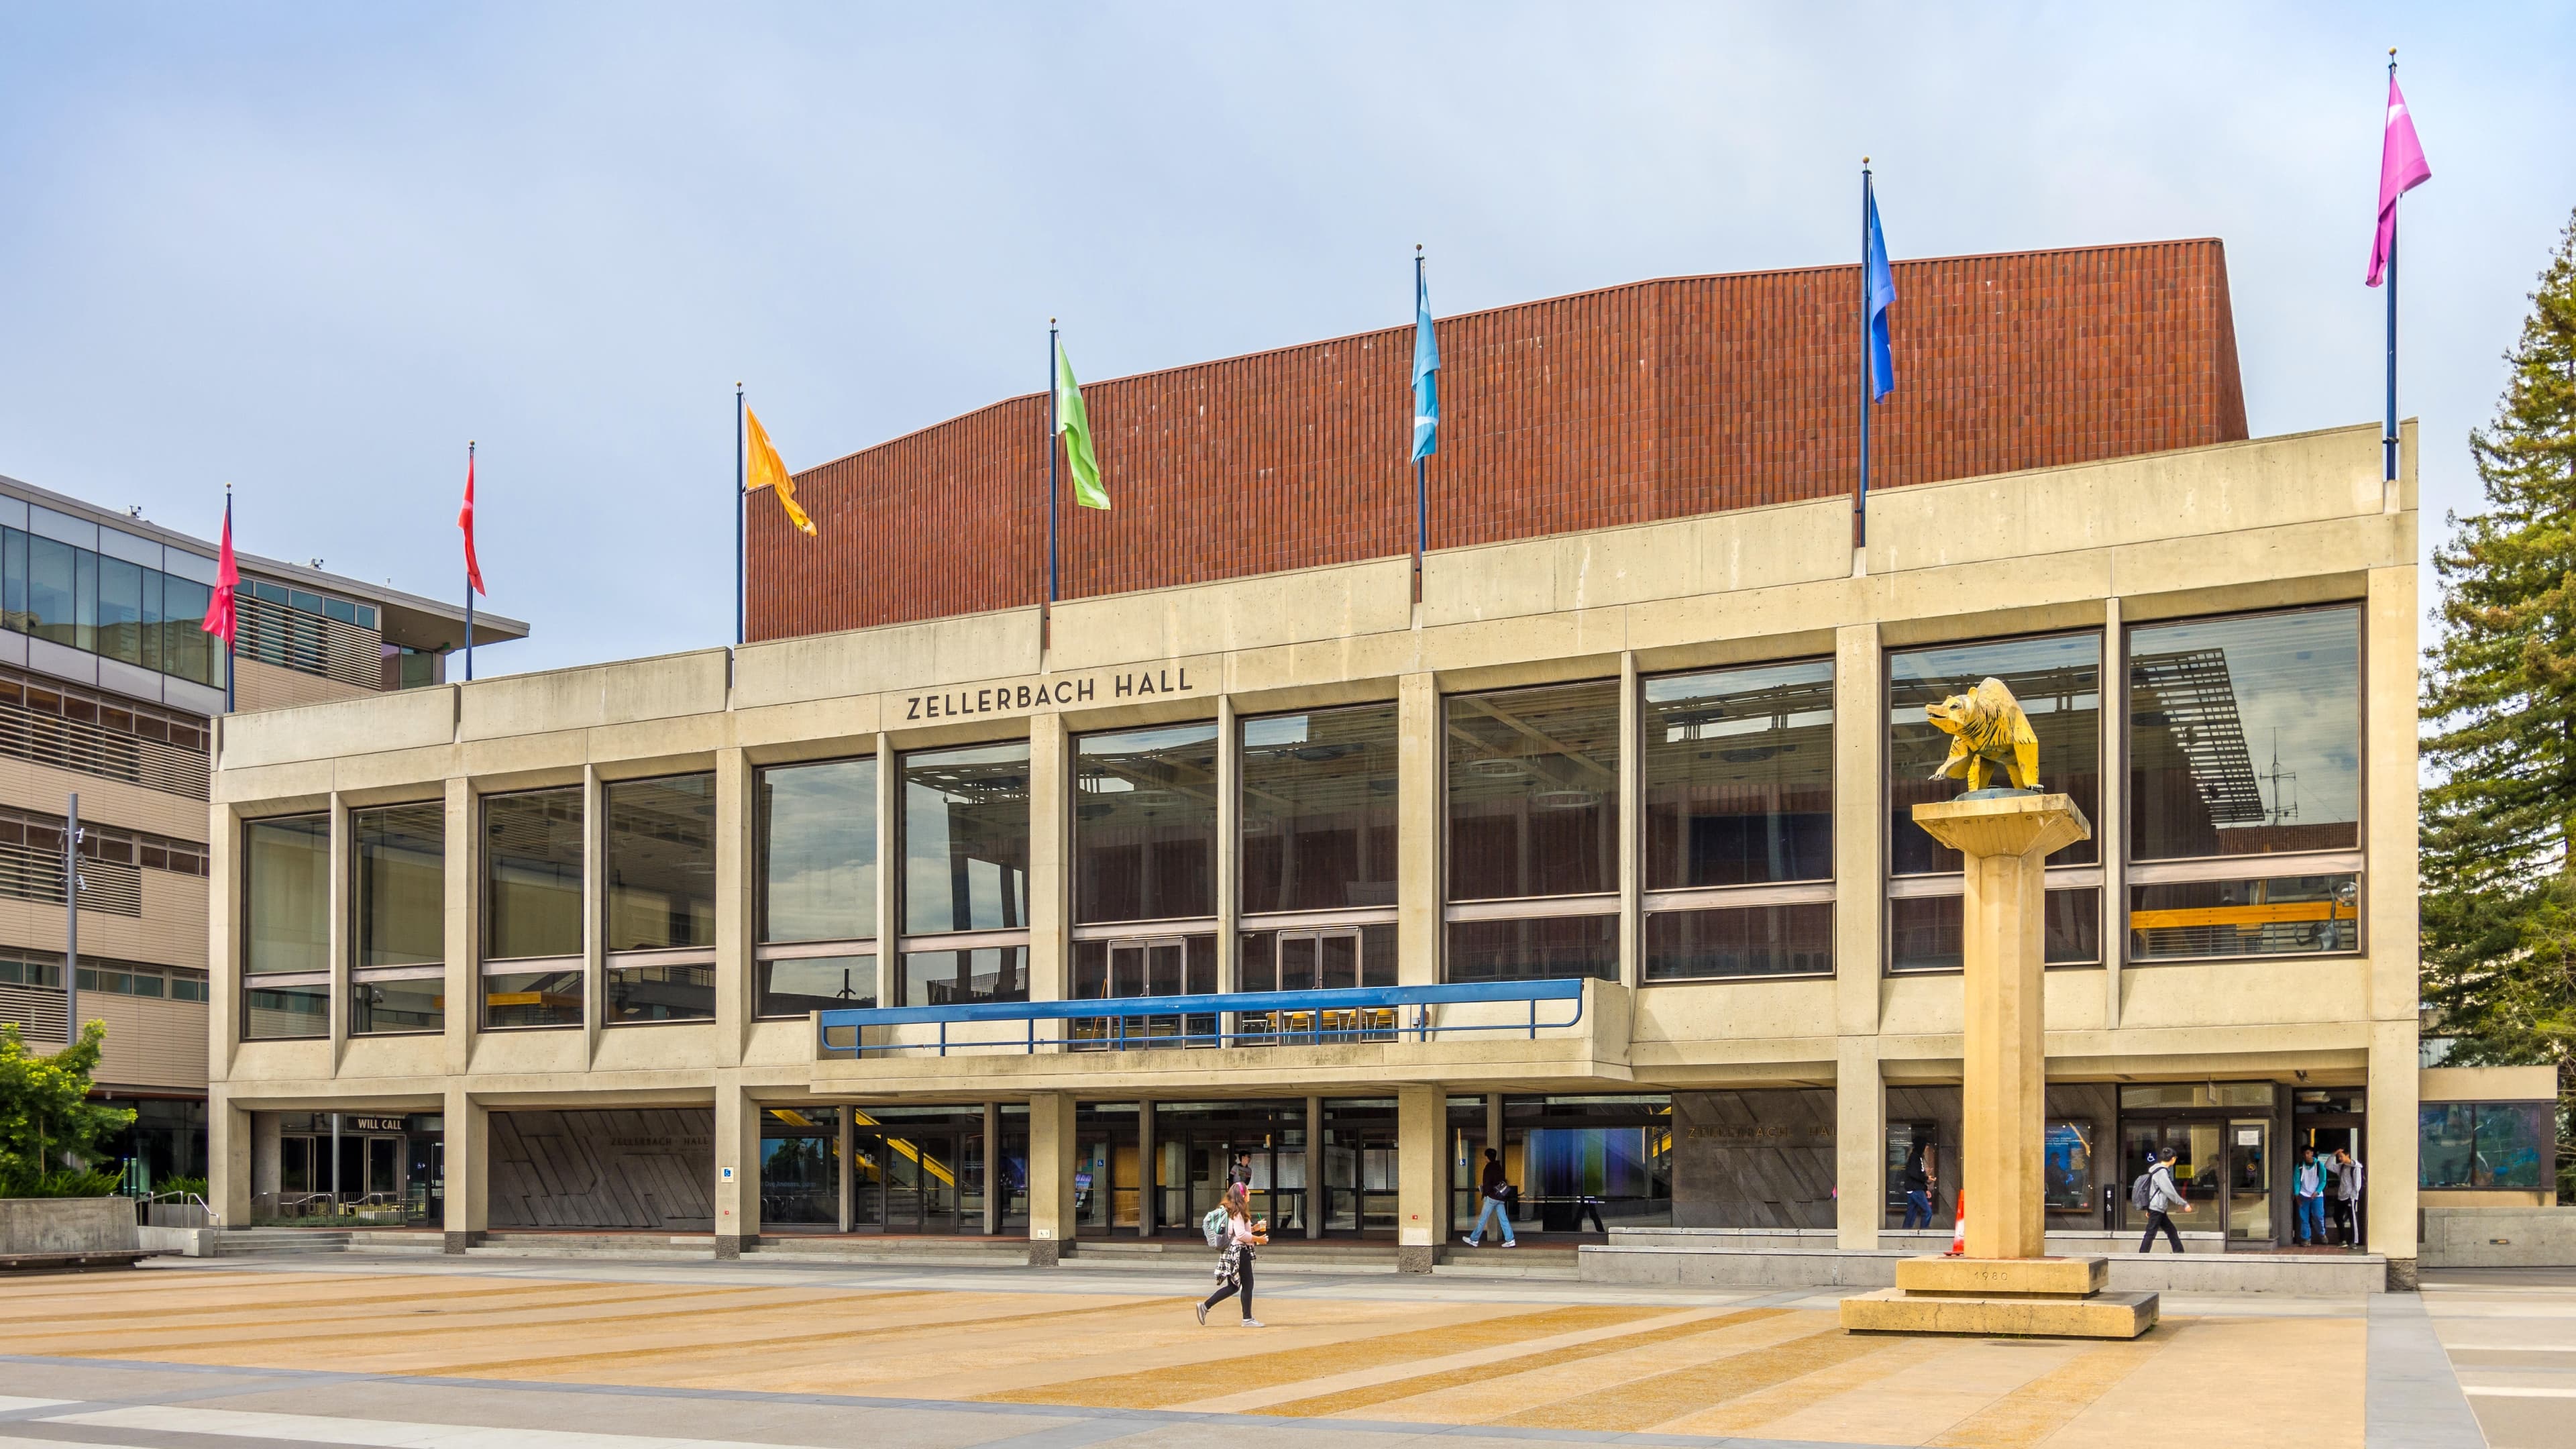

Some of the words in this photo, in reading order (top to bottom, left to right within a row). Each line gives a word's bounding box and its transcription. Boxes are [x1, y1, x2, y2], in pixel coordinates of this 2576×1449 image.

[906, 678, 1095, 720] ZELLERBACH
[1116, 667, 1193, 698] HALL
[358, 1118, 379, 1130] WILL
[381, 1119, 402, 1130] CALL
[1808, 1126, 1837, 1138] HAL
[610, 1136, 672, 1146] ZELLERBACH
[684, 1136, 708, 1146] HALL
[1974, 1271, 2008, 1281] 1980
